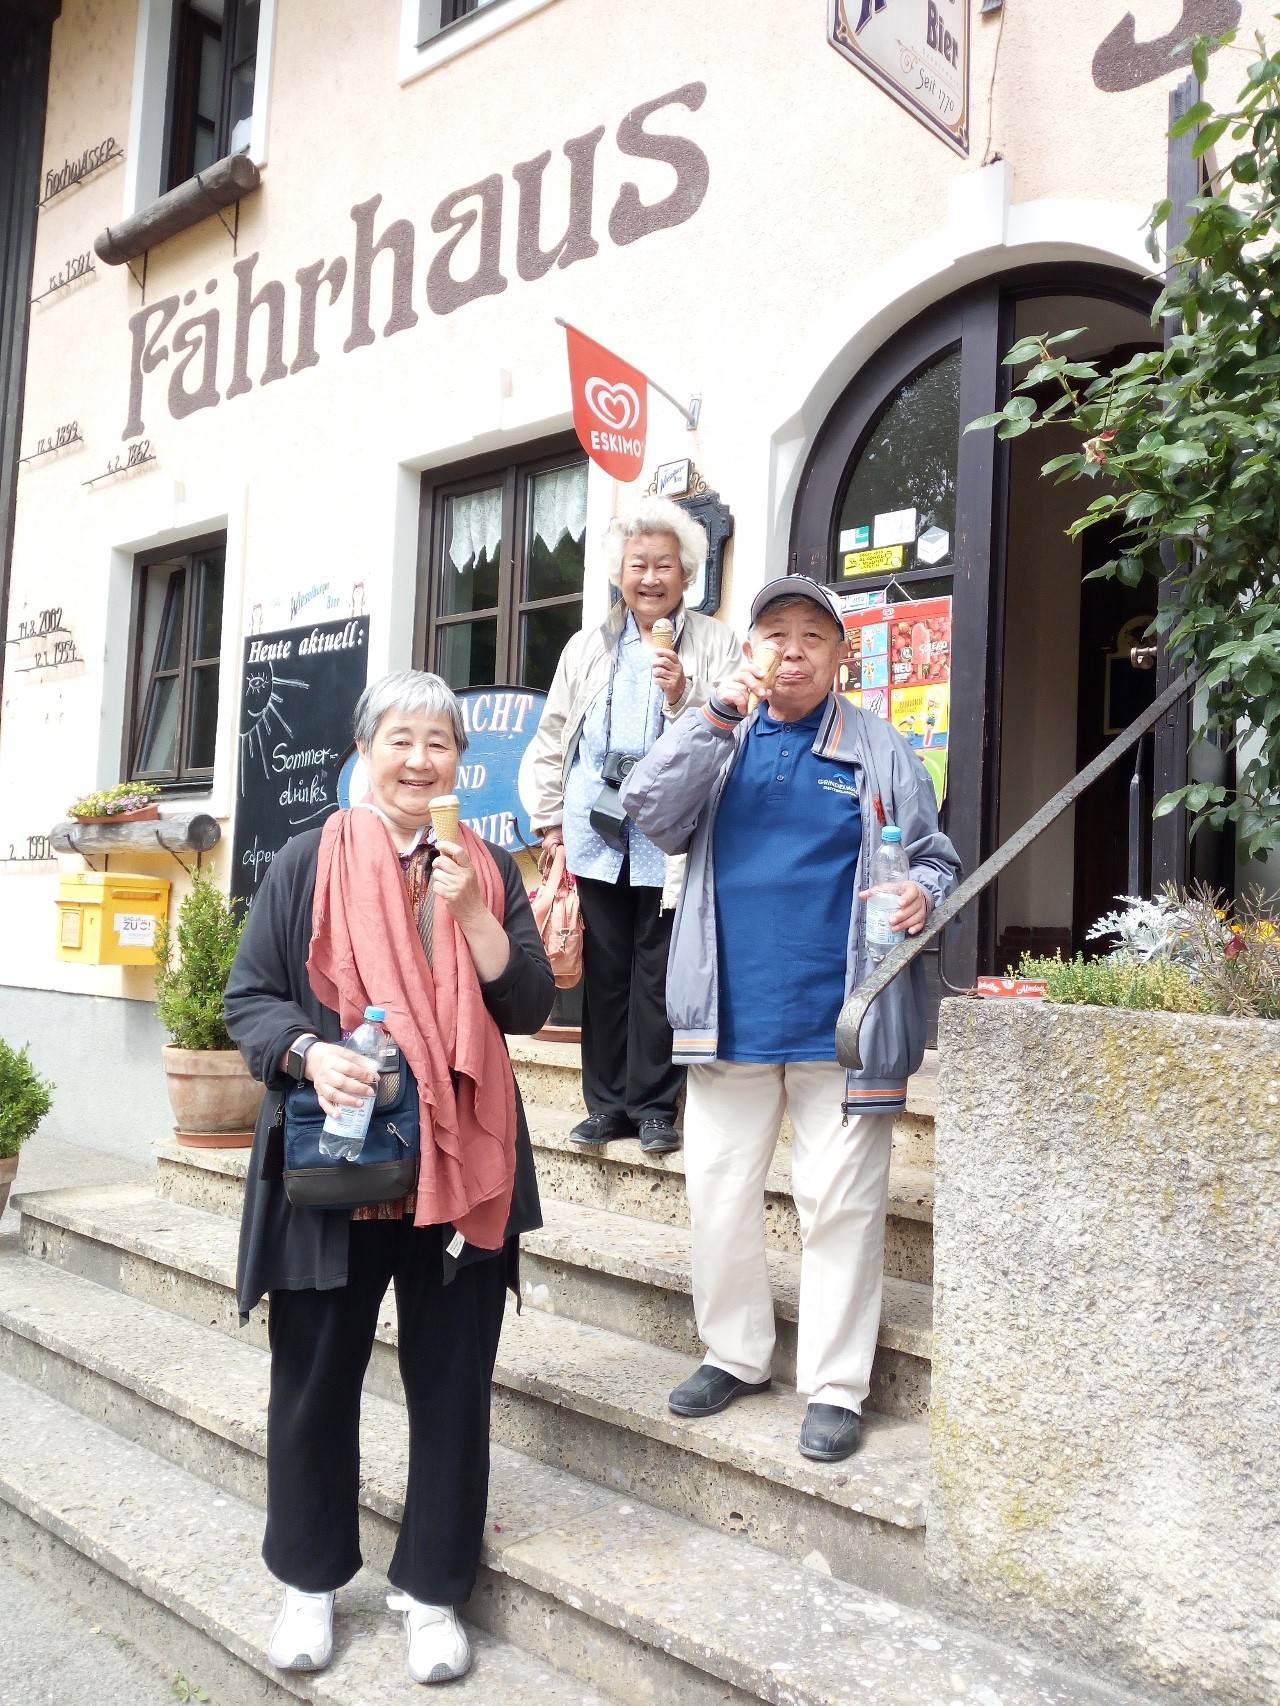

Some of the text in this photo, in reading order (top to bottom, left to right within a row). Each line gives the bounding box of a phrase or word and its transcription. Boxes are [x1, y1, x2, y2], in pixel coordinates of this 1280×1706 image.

[927, 0, 958, 71] Bier
[915, 67, 936, 94] Seit
[938, 89, 955, 113] 1770
[122, 80, 710, 441] Fährhaus
[590, 431, 642, 458] ESKIMO
[247, 620, 364, 663] Heute aktuell:
[894, 662, 912, 674] NEU
[279, 774, 328, 806] drinks
[455, 764, 486, 790] ND
[122, 921, 138, 931] ZU
